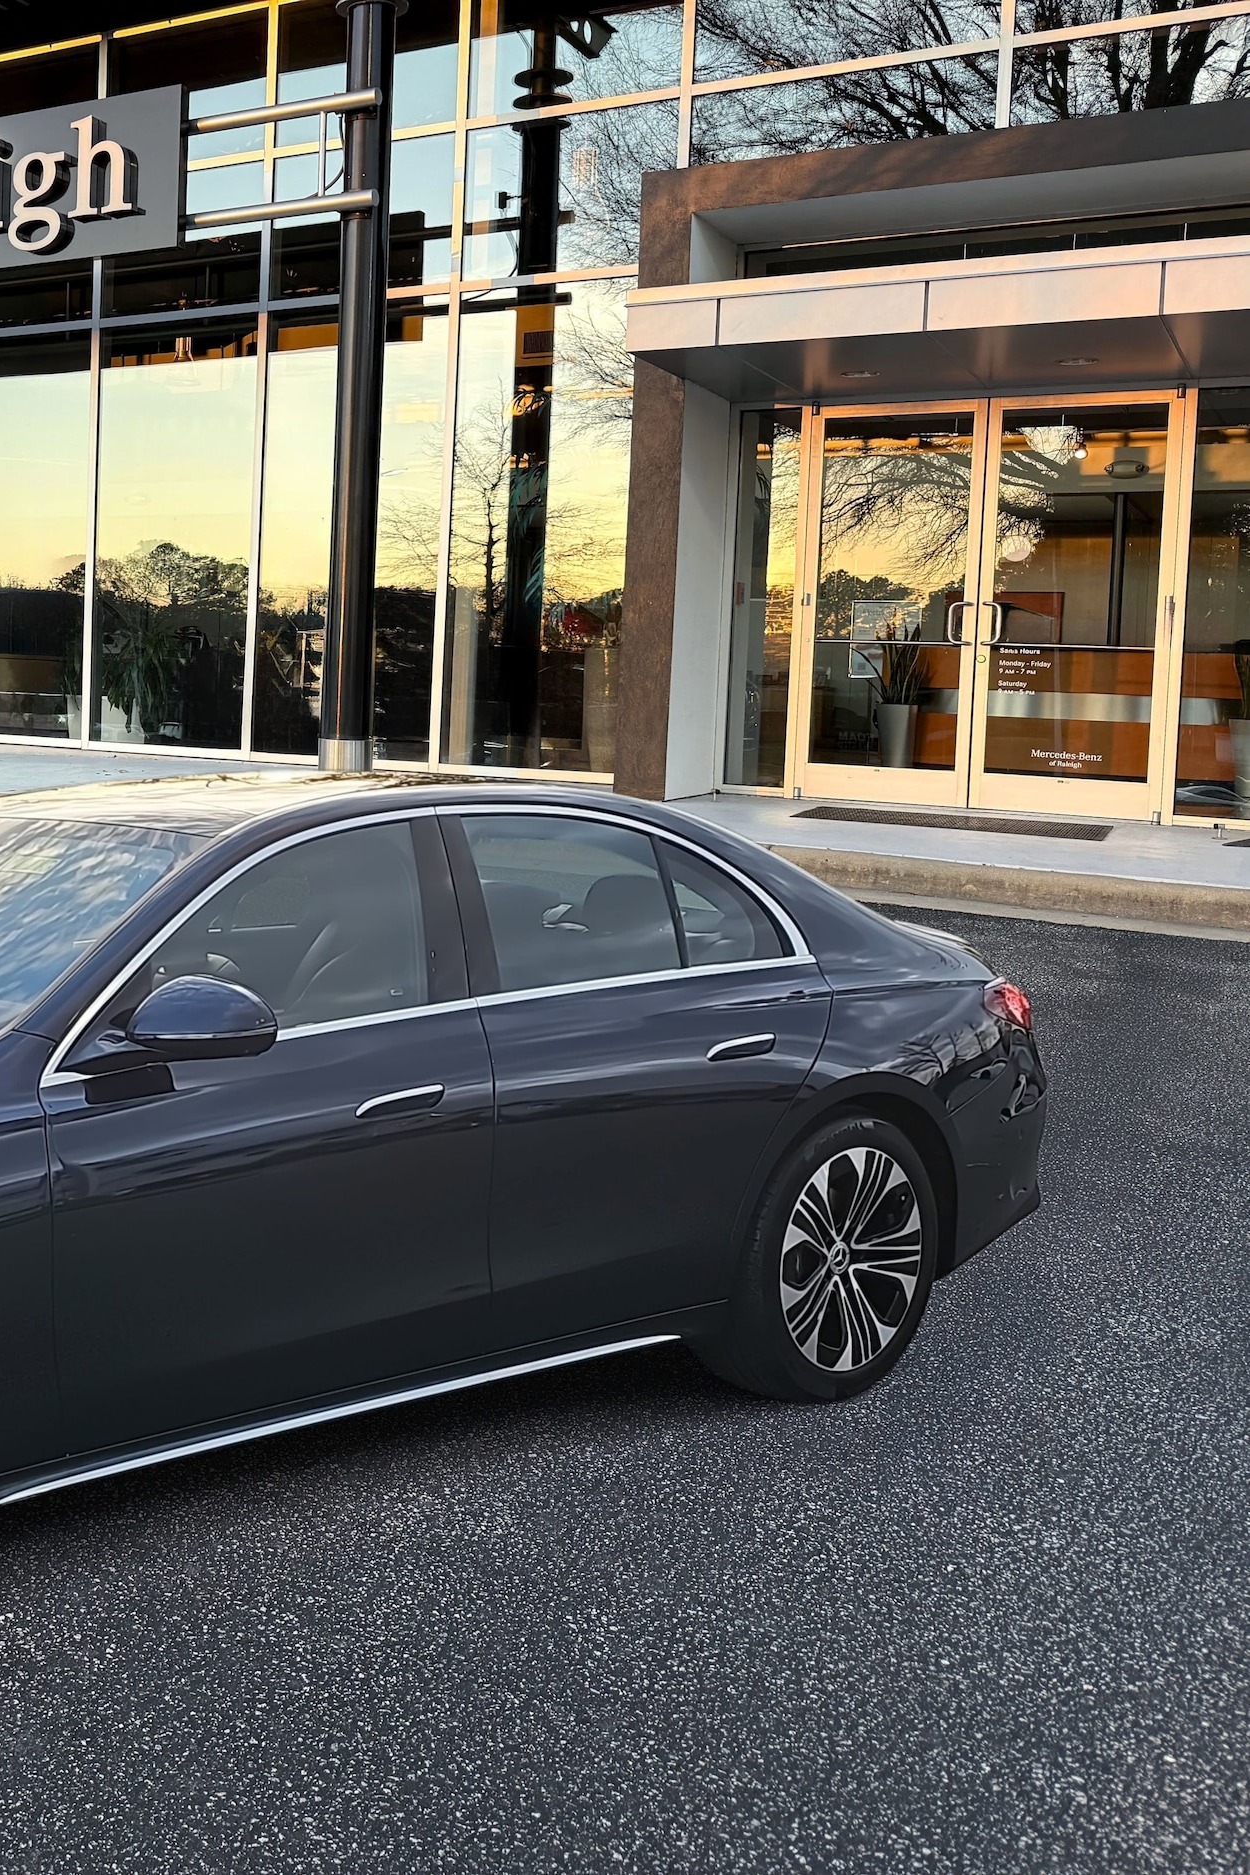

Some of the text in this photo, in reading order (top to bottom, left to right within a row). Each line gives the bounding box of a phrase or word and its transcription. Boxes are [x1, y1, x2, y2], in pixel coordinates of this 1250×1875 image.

[998, 680, 1027, 688] Saturday
[1031, 749, 1102, 761] Mercedes-Benz
[1057, 761, 1083, 769] Raleigh
